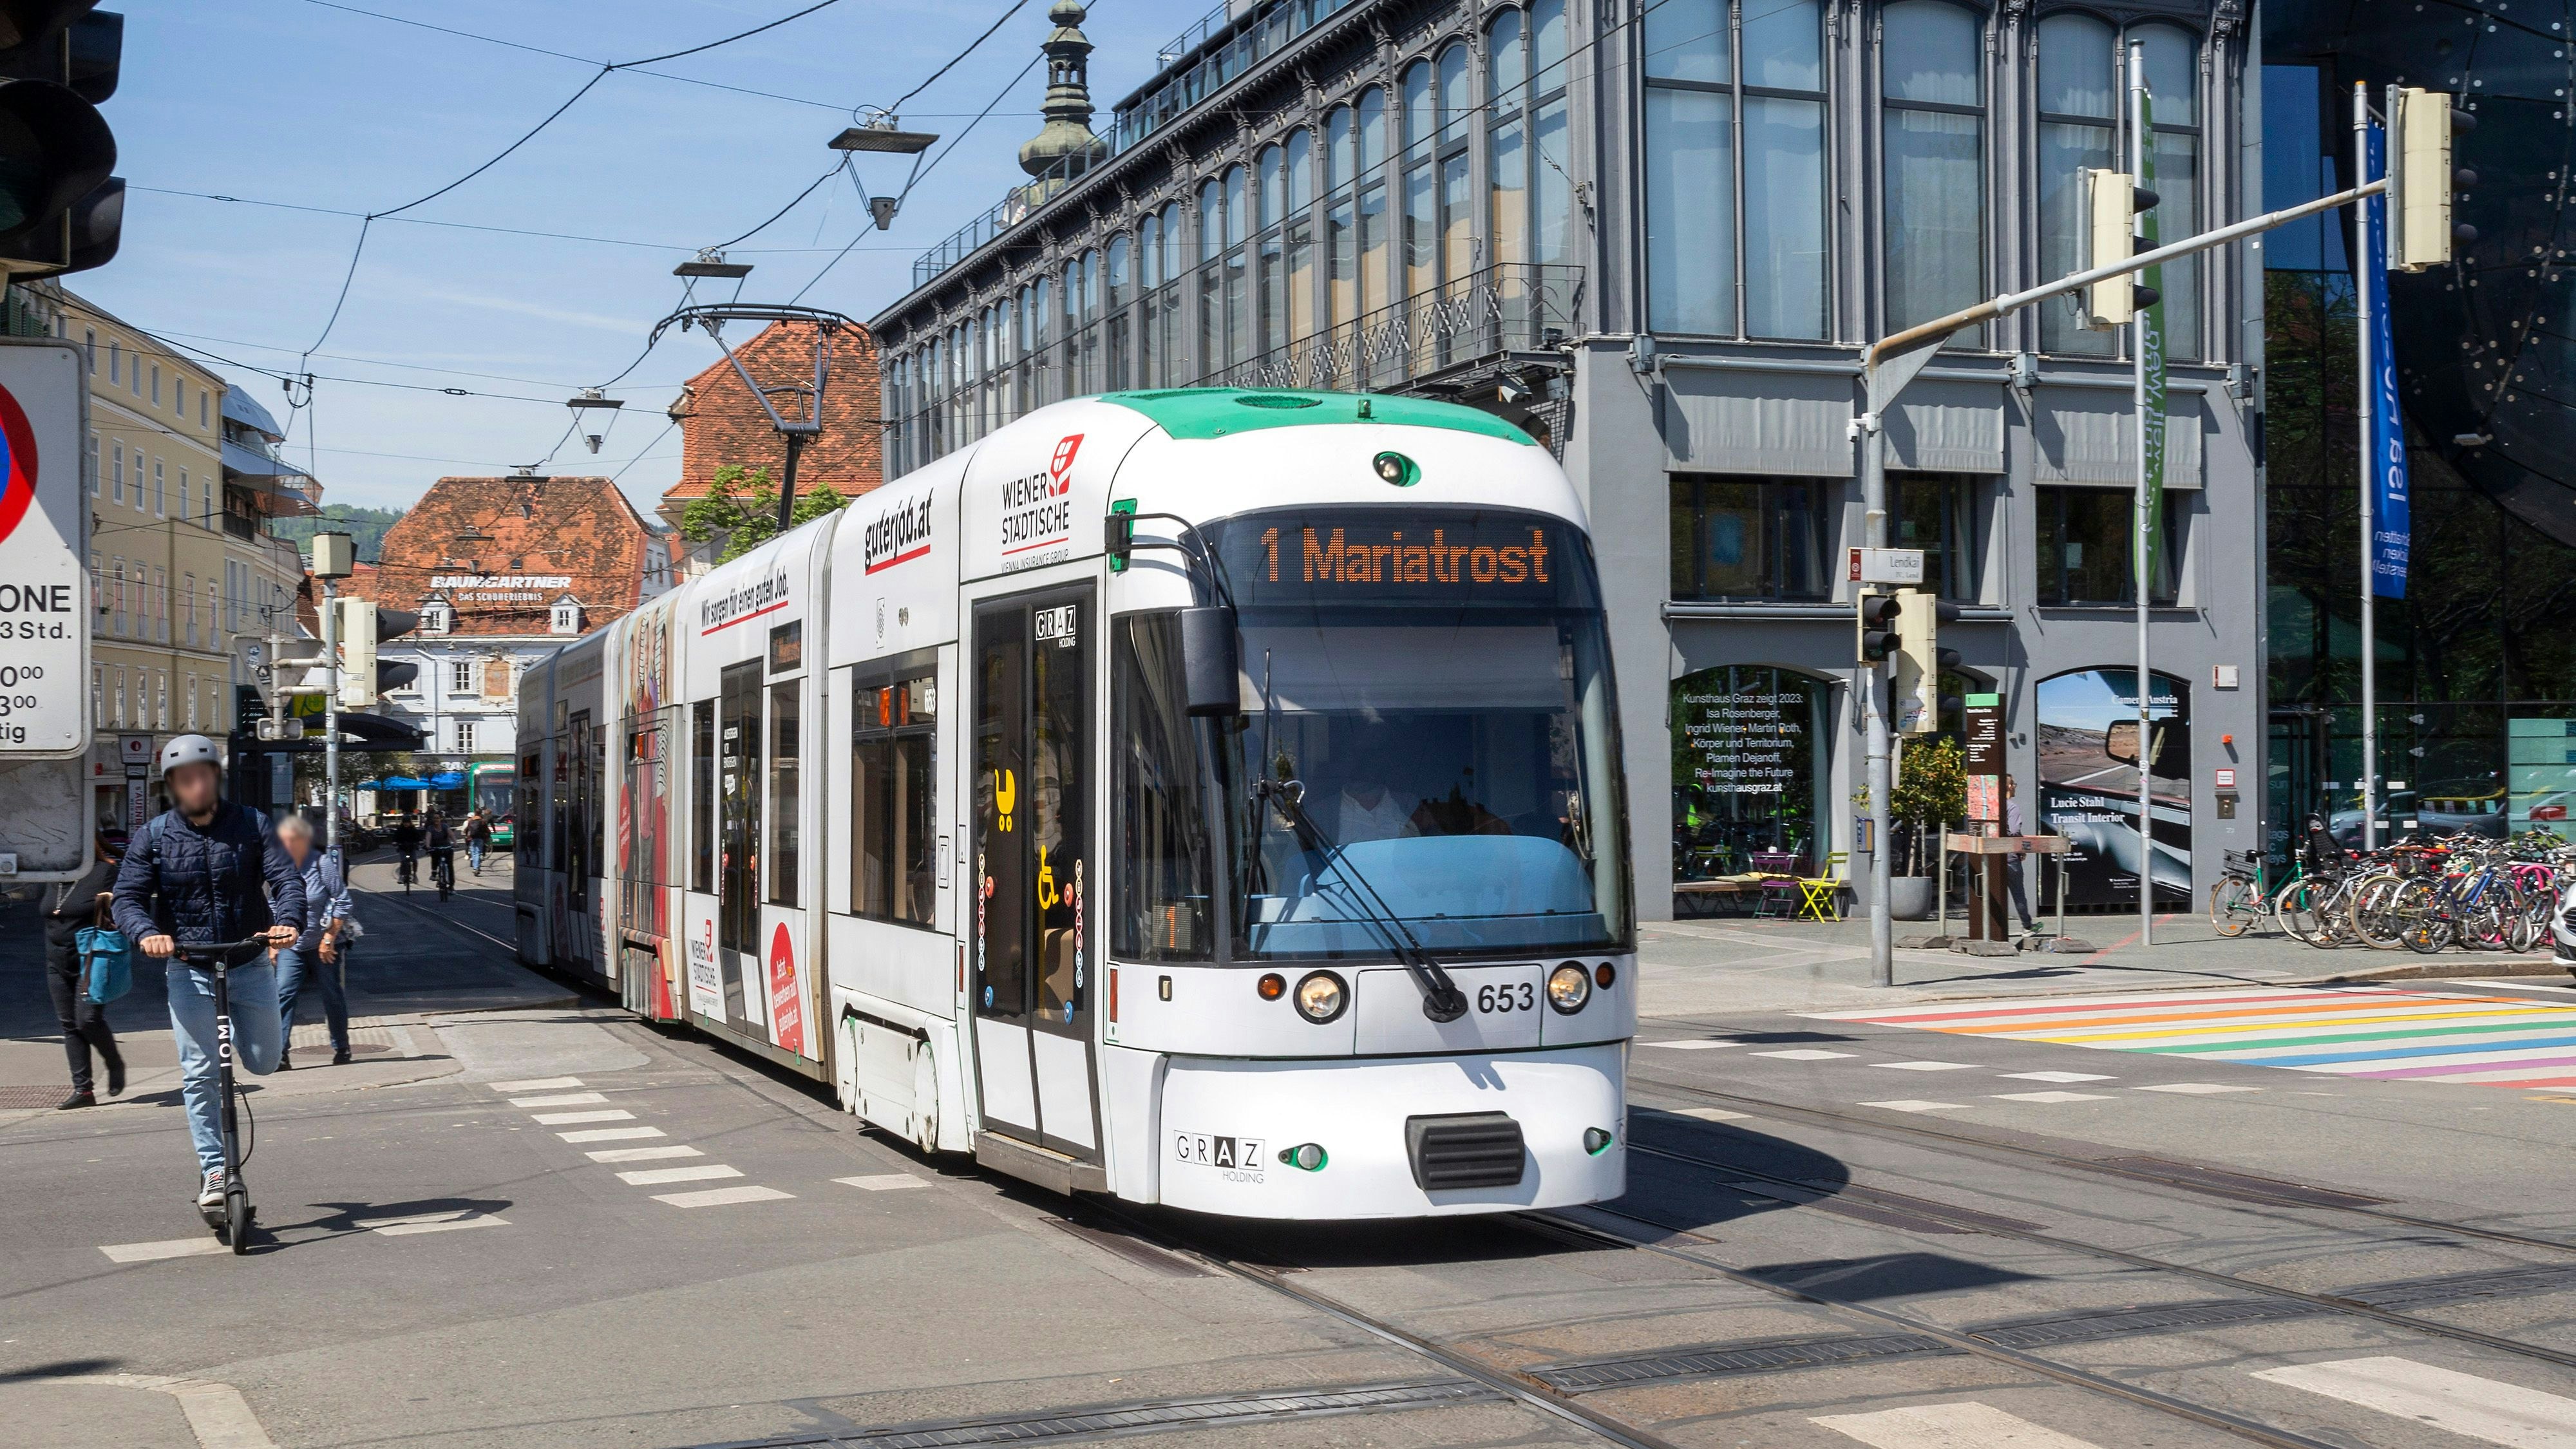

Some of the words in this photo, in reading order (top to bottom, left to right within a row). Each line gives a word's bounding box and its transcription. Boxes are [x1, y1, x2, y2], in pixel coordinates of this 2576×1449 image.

[1003, 472, 1046, 511] WIENER
[865, 487, 934, 571] guterjob.at
[1002, 501, 1070, 545] STÄDTISCHE
[1261, 527, 1278, 582] 1
[1303, 527, 1549, 583] Mariatrost
[1001, 561, 1019, 574] VIENNA
[1020, 553, 1049, 571] INSURANCE
[1050, 549, 1069, 564] GROUP
[430, 576, 572, 588] BAUMGARTNER
[458, 592, 473, 601] DAS
[701, 599, 710, 627] Wir
[711, 597, 728, 627] sorgen
[739, 582, 754, 613] einen
[755, 574, 773, 614] guten
[775, 565, 789, 599] Job.
[1036, 608, 1074, 638] GRAZ
[925, 687, 936, 713] 653
[1683, 694, 1730, 703] Kunsthaus
[1732, 694, 1754, 703] Graz
[1756, 694, 1777, 705] zeigt
[1779, 693, 1804, 703] 2023:
[2112, 695, 2140, 705] Camer
[1707, 709, 1720, 718] Isa
[1722, 708, 1781, 720] Rosenberger,
[1685, 723, 1710, 735] Ingrid
[1748, 723, 1776, 733] Martin
[1778, 723, 1802, 734] Roth,
[1693, 738, 1723, 750] Körper
[1725, 738, 1743, 748] und
[1745, 738, 1794, 749] Territorium,
[1706, 753, 1741, 762] Plamen
[1742, 752, 1782, 764] Dejanoff,
[1695, 768, 1747, 779] Re-Imagine
[1748, 767, 1762, 777] the
[1765, 767, 1794, 777] Future
[1707, 782, 1783, 794] kunsthausgraz.at
[2050, 797, 2078, 808] Lucie
[2079, 797, 2105, 808] Stahl
[2050, 813, 2085, 824] Transit
[2087, 812, 2125, 823] Interior
[1166, 905, 1175, 949] 1
[1478, 982, 1535, 1014] 653
[1177, 1135, 1258, 1167] GRAZ
[1223, 1171, 1264, 1184] HOLDING
